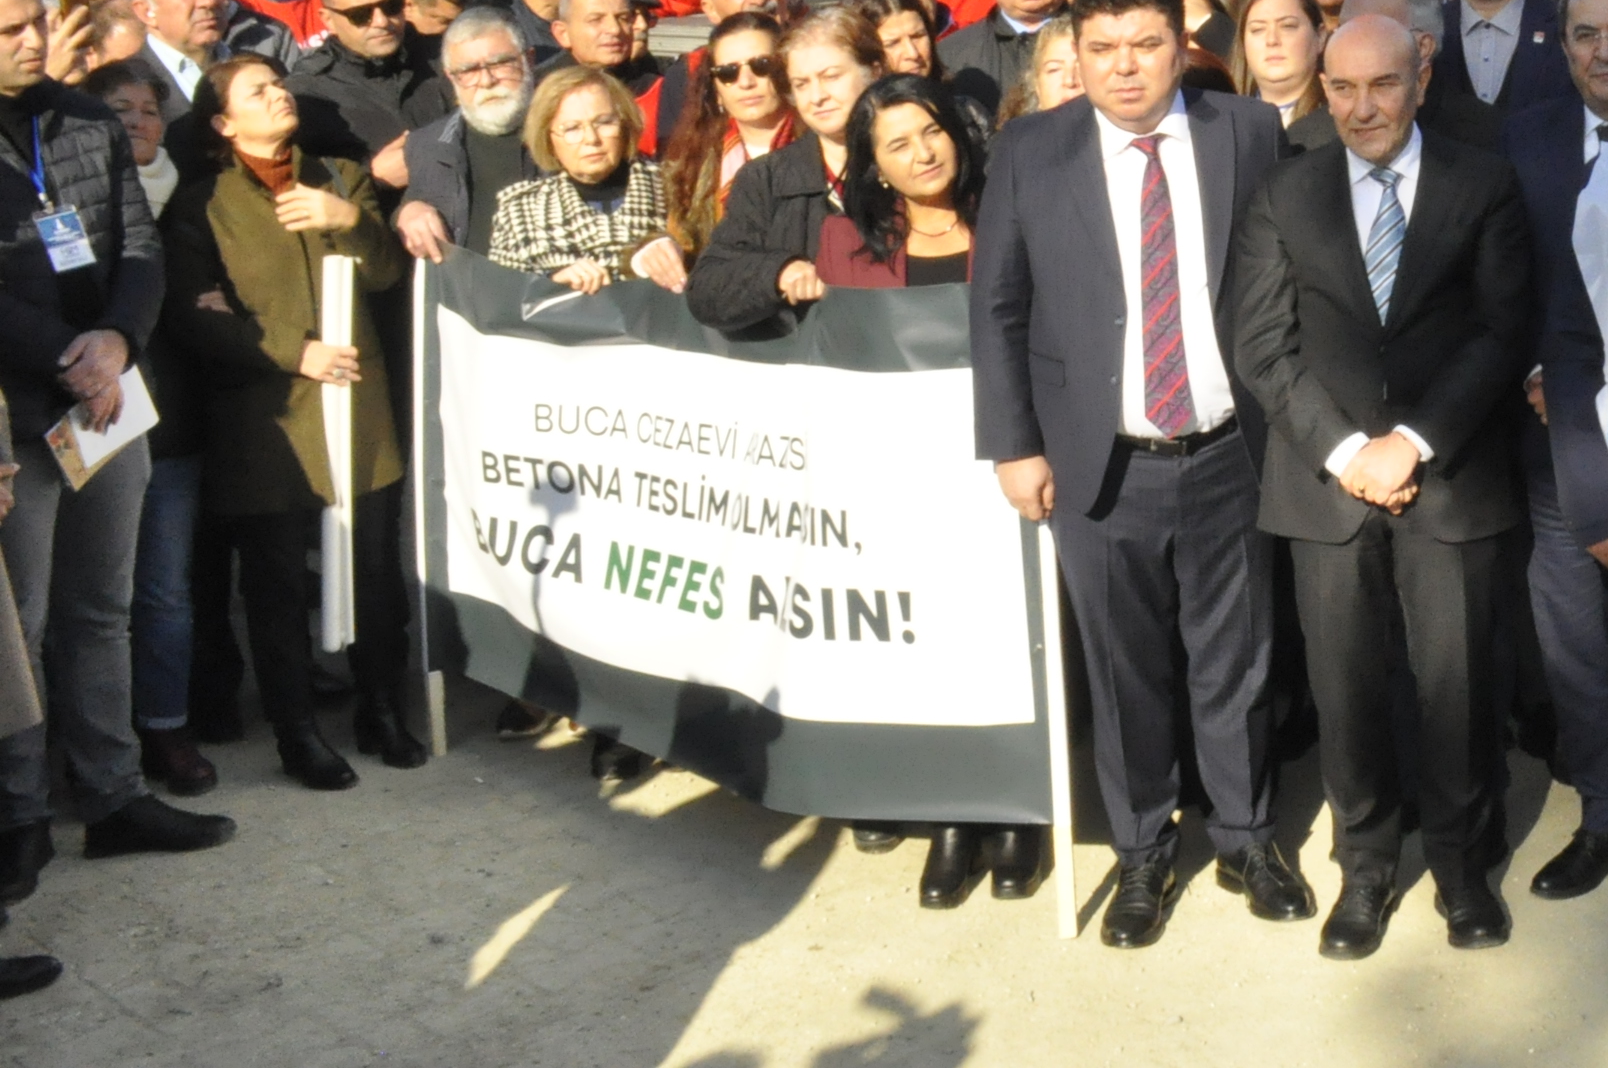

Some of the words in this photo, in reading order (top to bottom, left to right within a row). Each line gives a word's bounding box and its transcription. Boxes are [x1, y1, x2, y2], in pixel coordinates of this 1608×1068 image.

[534, 403, 628, 439] BUCA
[637, 411, 739, 459] CEZAEVİ
[481, 450, 622, 503] BETONA
[634, 470, 730, 526] TESLİM
[471, 507, 583, 584] BUCA
[603, 540, 725, 620] NEFES
